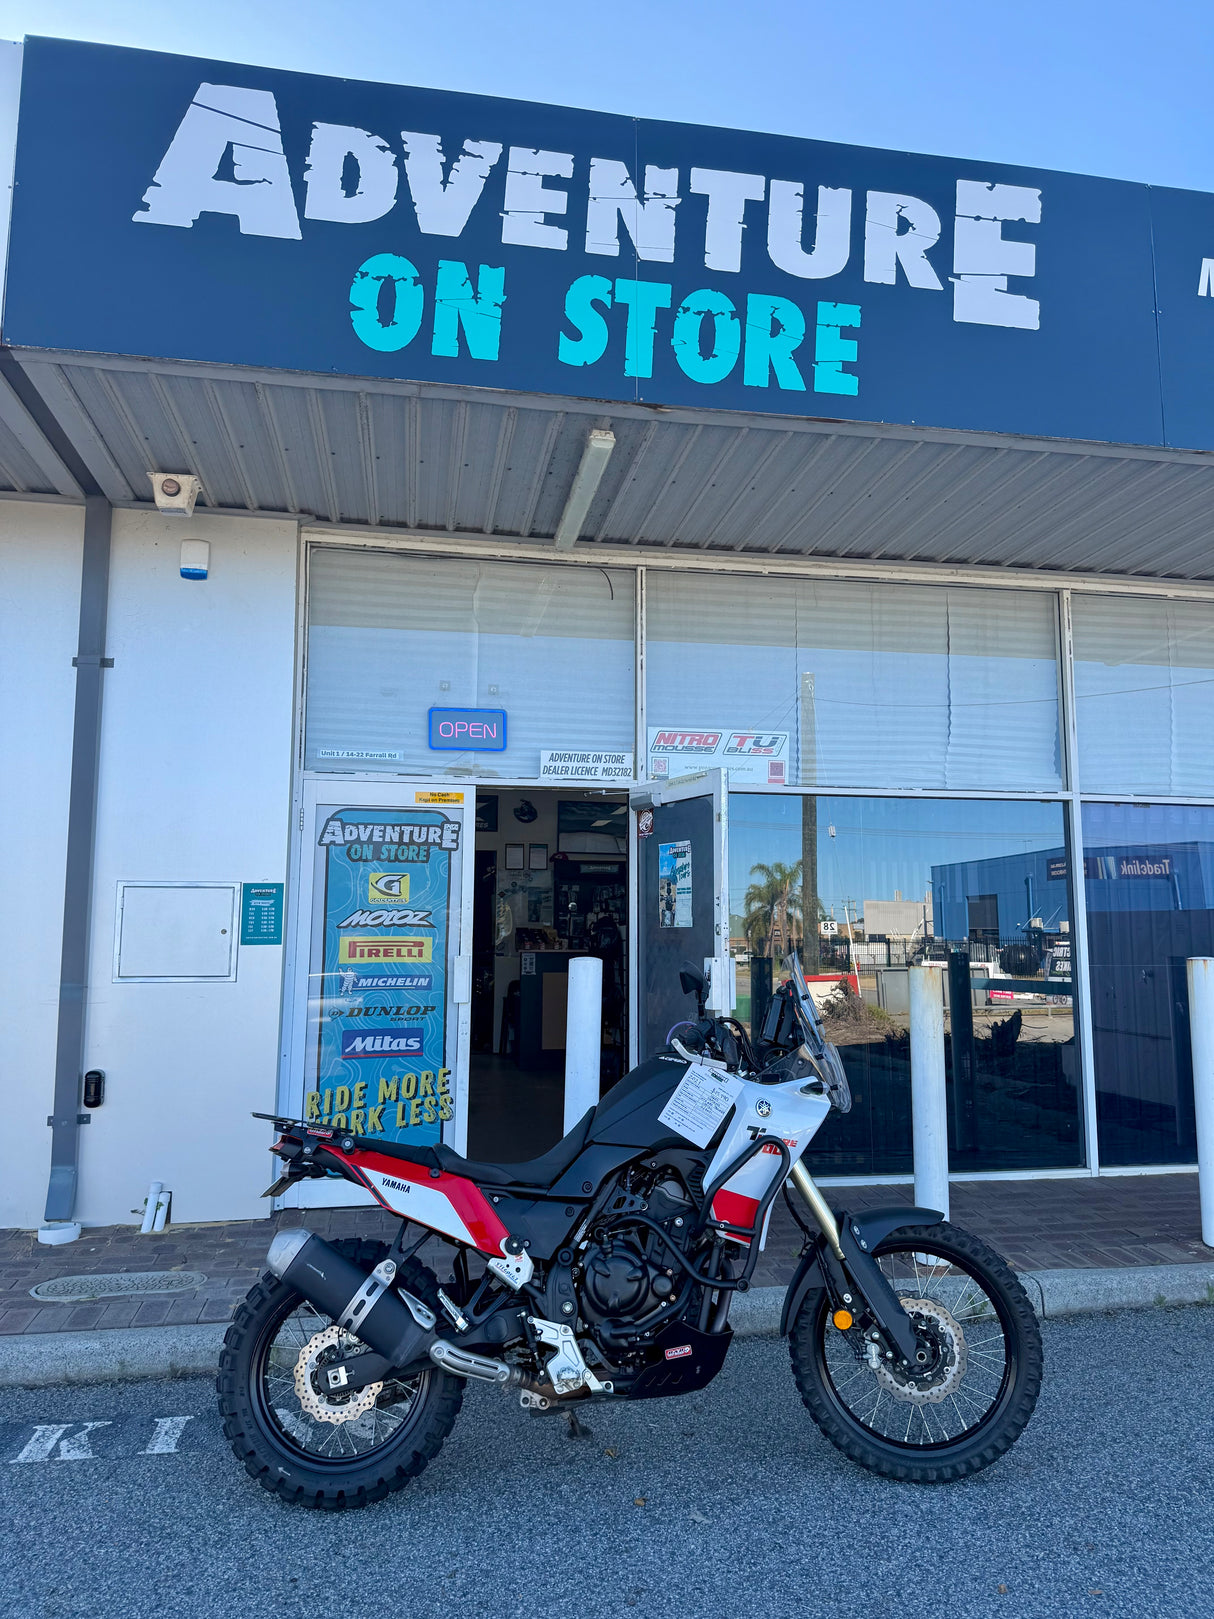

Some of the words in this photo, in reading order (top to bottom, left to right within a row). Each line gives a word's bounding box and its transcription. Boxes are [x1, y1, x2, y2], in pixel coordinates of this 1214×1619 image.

[132, 82, 1043, 331] ADVENTURE
[349, 253, 507, 361] ON
[558, 274, 862, 396] STORE
[439, 721, 497, 739] OPEN
[655, 733, 720, 746] NITRO
[548, 753, 591, 763] ADVENTURE
[591, 754, 602, 764] ON
[603, 754, 626, 764] STORE
[726, 746, 774, 754] BLISS
[542, 765, 569, 775] DEALER
[570, 766, 599, 776] LICENCE
[601, 767, 633, 777] MD32182
[320, 820, 460, 849] ADVENTURE
[350, 844, 374, 860] ON
[380, 845, 428, 861] STORE
[348, 941, 424, 958] PIRELLI
[358, 978, 430, 987] MICHELIN
[346, 1006, 436, 1017] DUNLOP
[345, 1036, 421, 1053] Mitas
[305, 1081, 368, 1118] RIDE
[378, 1068, 451, 1104] MORE
[396, 1094, 453, 1127] LESS
[382, 1177, 411, 1193] YAMAHA
